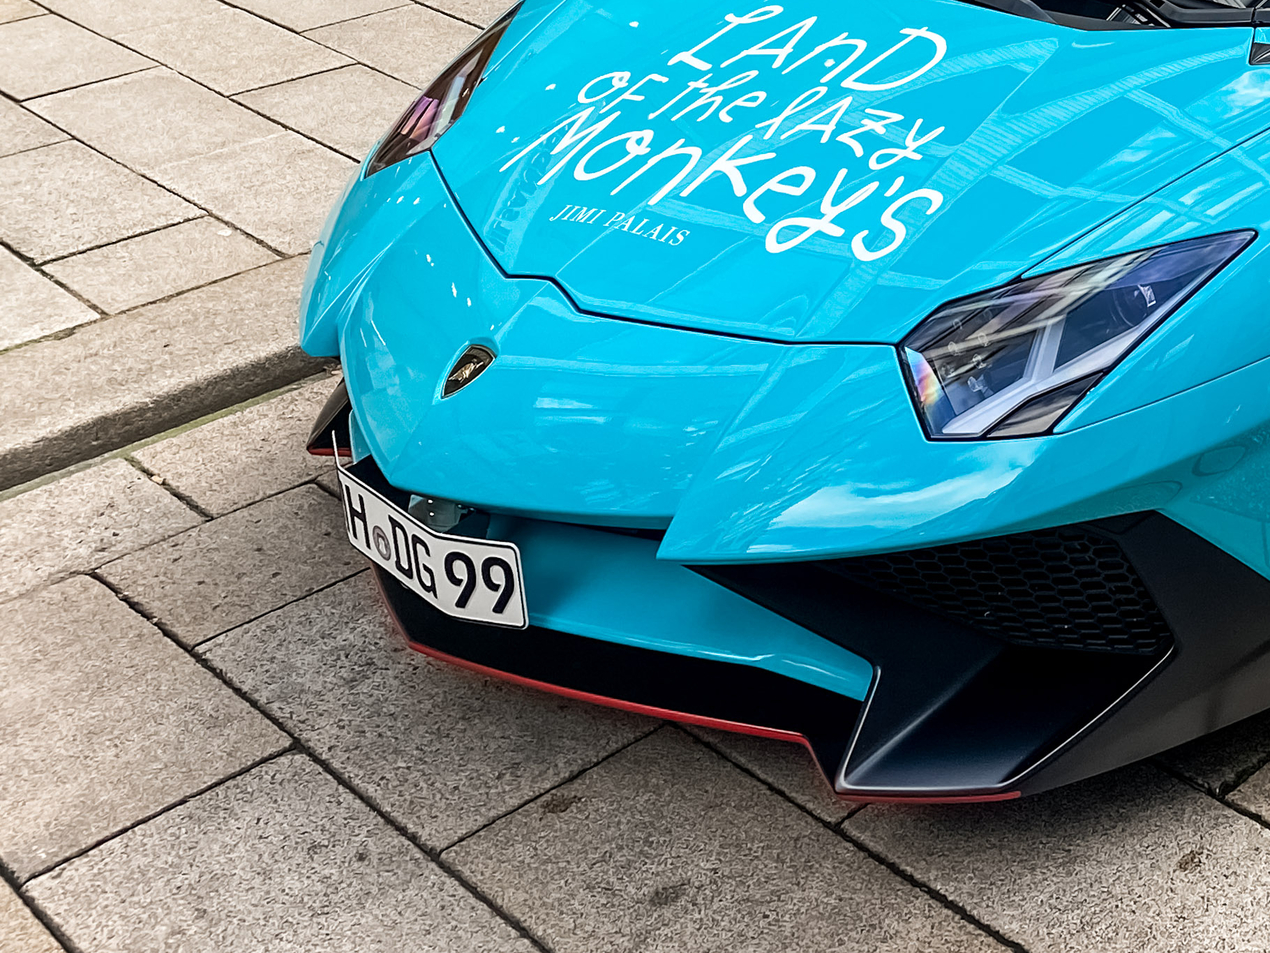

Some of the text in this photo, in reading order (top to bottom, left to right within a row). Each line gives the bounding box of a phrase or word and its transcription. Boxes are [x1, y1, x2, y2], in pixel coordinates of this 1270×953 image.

[549, 204, 691, 246] JIMI PALAIS
[344, 484, 371, 551] H
[444, 551, 515, 615] 99
